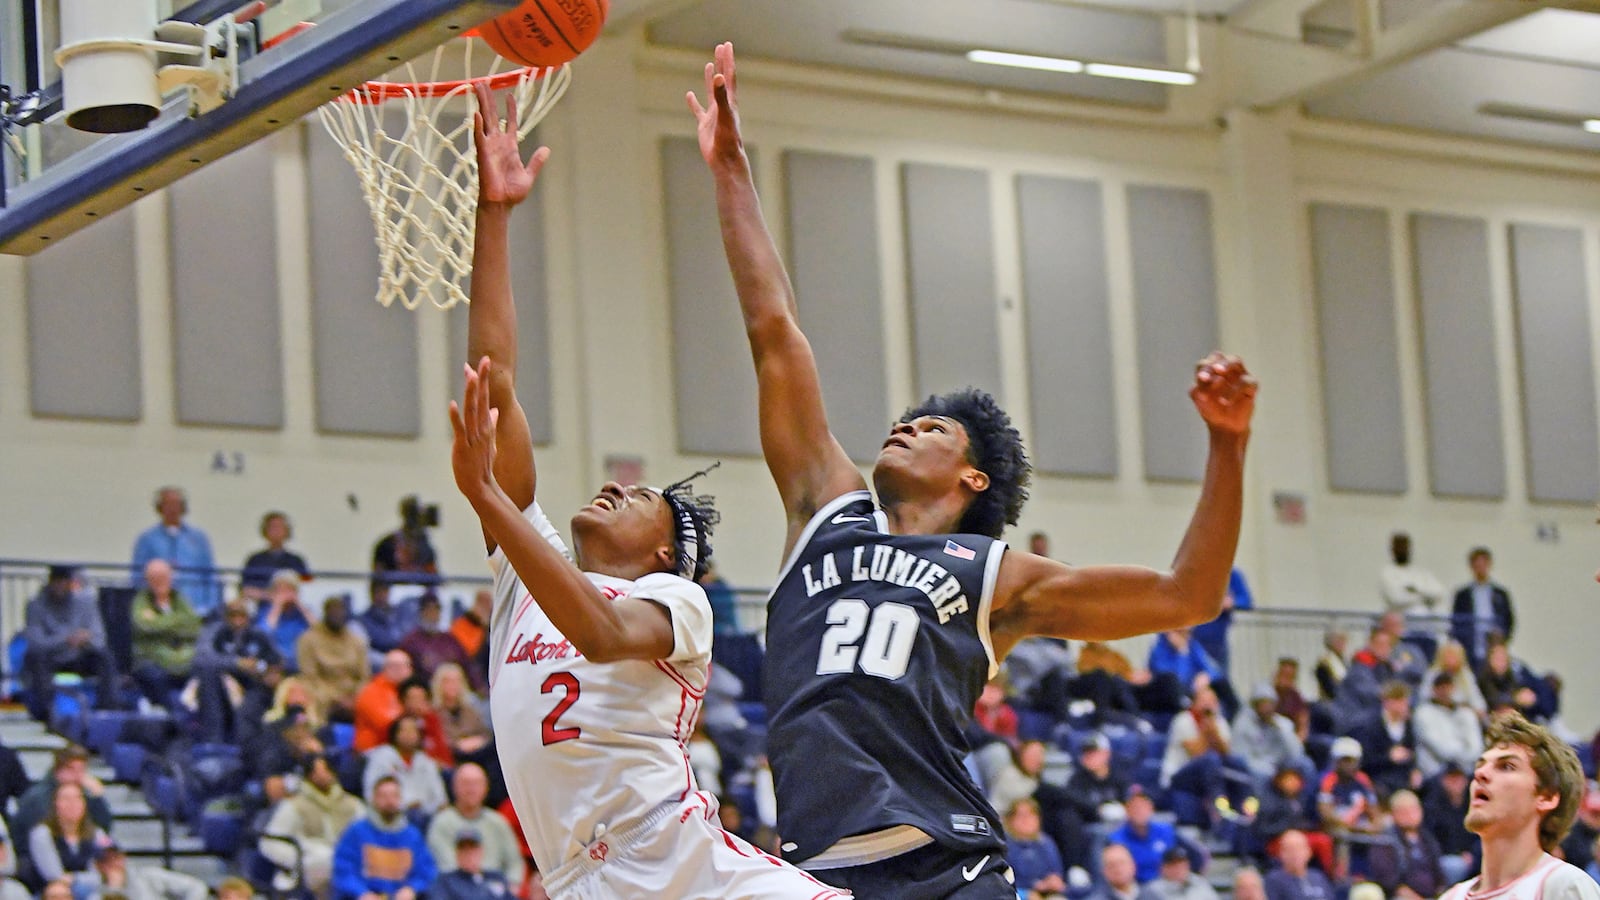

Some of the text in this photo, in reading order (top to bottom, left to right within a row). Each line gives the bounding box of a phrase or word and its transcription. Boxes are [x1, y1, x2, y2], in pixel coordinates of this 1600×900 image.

[802, 544, 969, 625] LA LUMIERE
[816, 598, 921, 681] 20
[540, 671, 582, 747] 2
